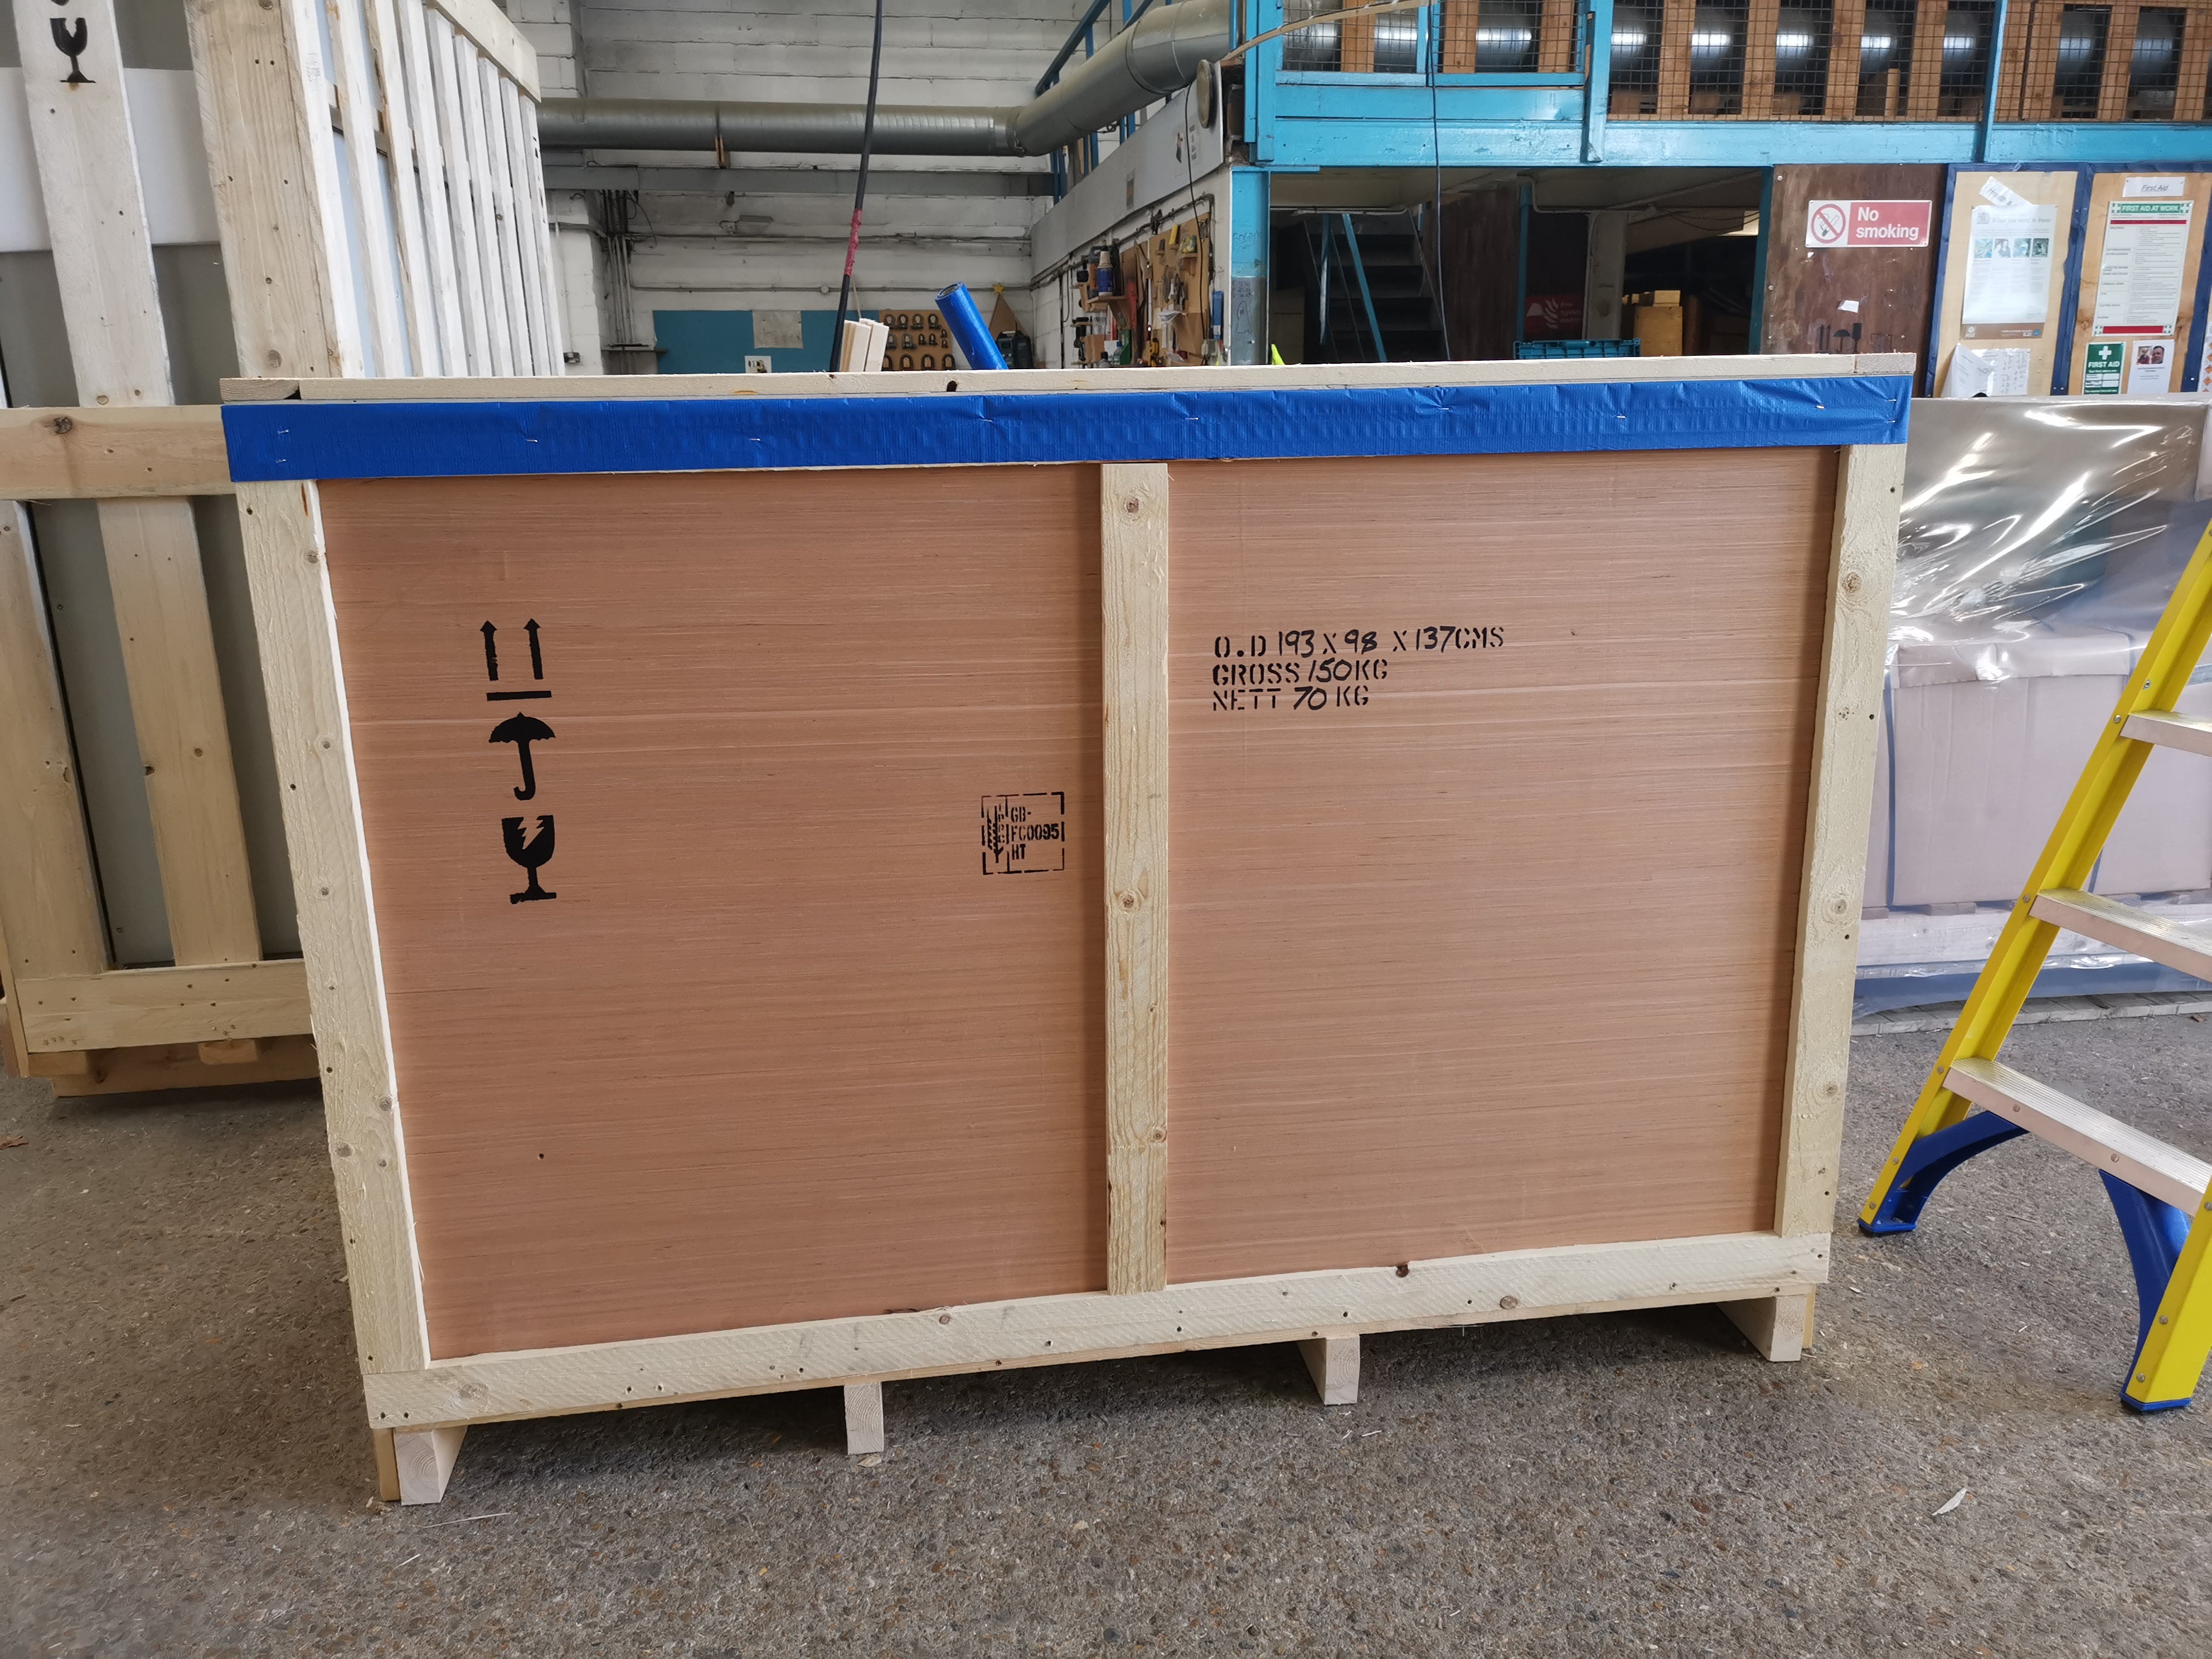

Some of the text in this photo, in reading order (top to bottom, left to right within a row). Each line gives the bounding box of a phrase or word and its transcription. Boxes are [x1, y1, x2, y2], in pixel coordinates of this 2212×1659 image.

[1857, 206, 1879, 222] No
[1855, 224, 1919, 241] smoking
[1279, 630, 1315, 657] 193
[1344, 629, 1378, 654] 98
[1213, 662, 1299, 686] GROSS
[1213, 685, 1369, 711] NETT 70 KG
[1011, 823, 1060, 842] FC0095
[1012, 843, 1026, 860] HT
